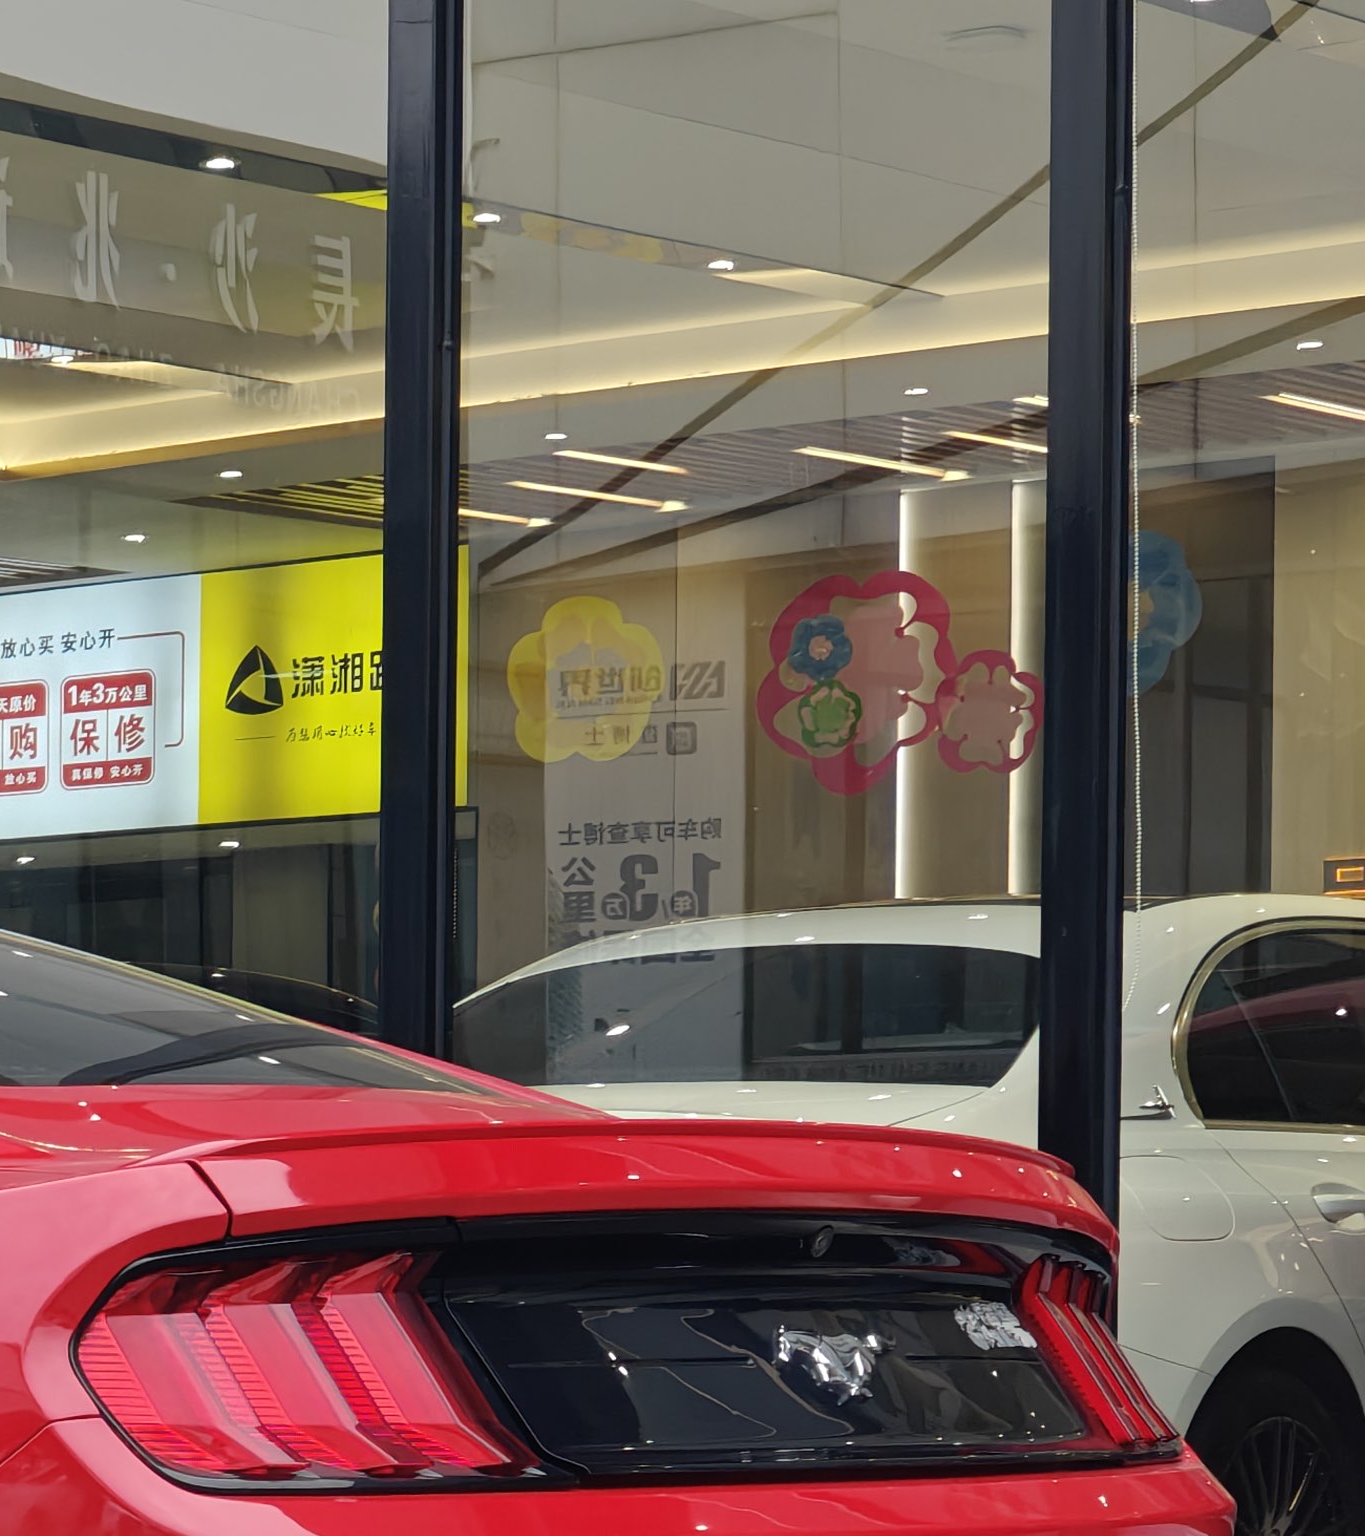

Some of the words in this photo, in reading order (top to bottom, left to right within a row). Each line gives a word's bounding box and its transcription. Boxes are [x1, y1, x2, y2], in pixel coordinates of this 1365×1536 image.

[0, 636, 54, 660] 放心买
[60, 627, 116, 653] 安心开
[67, 682, 148, 707] 1年3万公里
[70, 713, 146, 757] 保修
